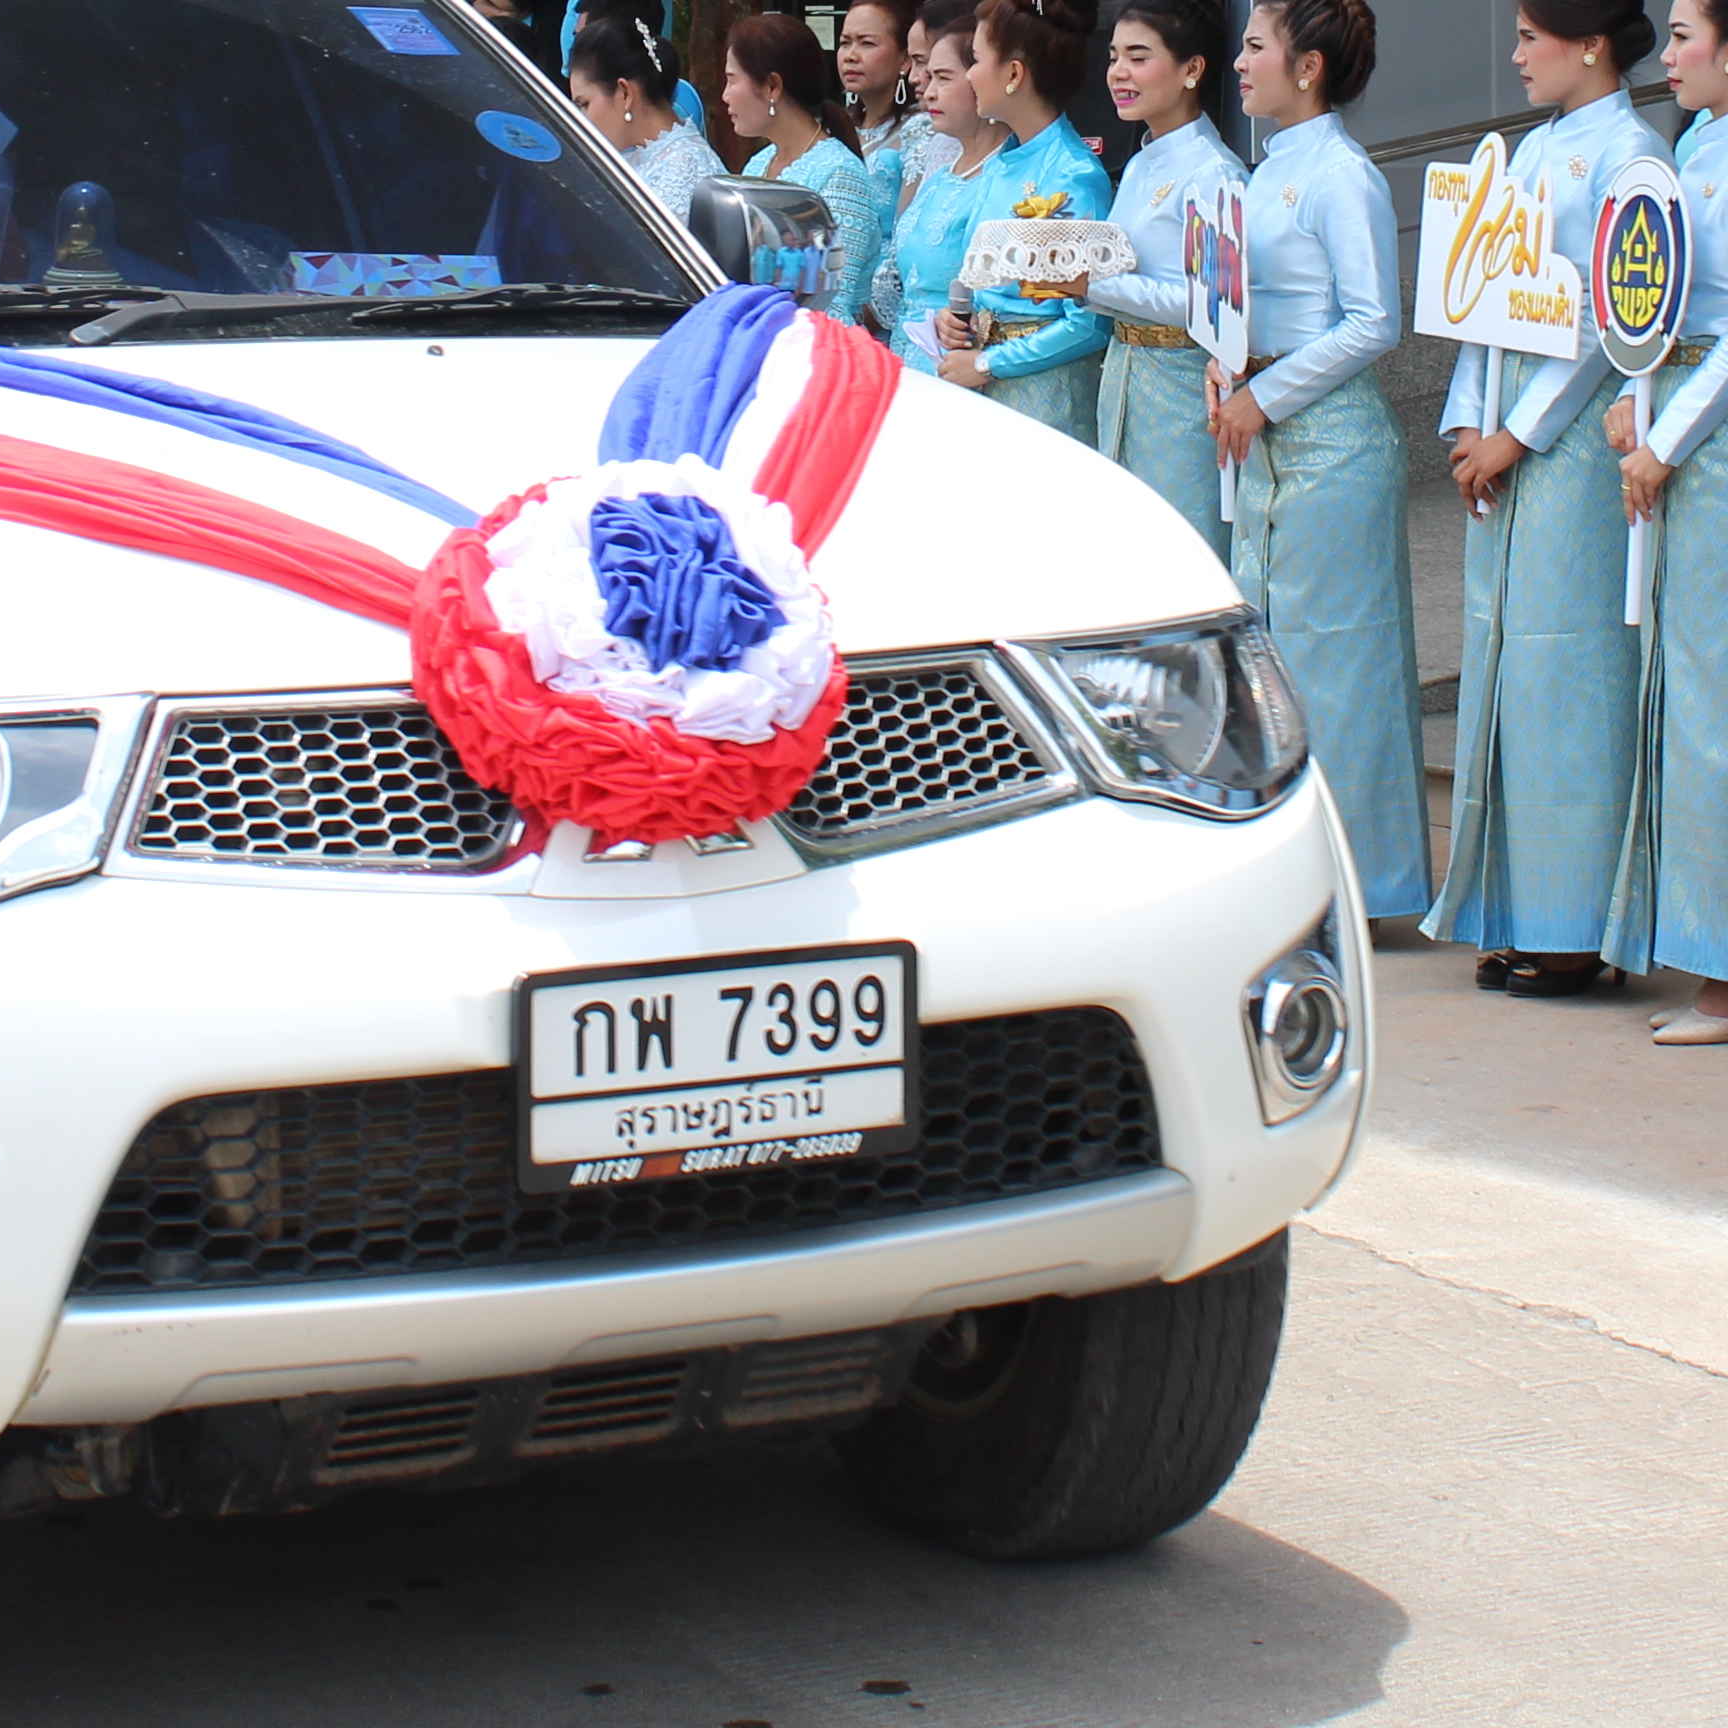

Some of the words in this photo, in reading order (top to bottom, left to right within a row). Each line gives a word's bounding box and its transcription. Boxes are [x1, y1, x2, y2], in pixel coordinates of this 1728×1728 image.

[1428, 169, 1472, 217] กองทุน
[571, 995, 673, 1076] กพ
[719, 975, 886, 1061] 7399
[615, 1076, 824, 1149] สุราษฎร์ธานี
[570, 1157, 644, 1186] MITSU
[680, 1145, 750, 1173] SURAT
